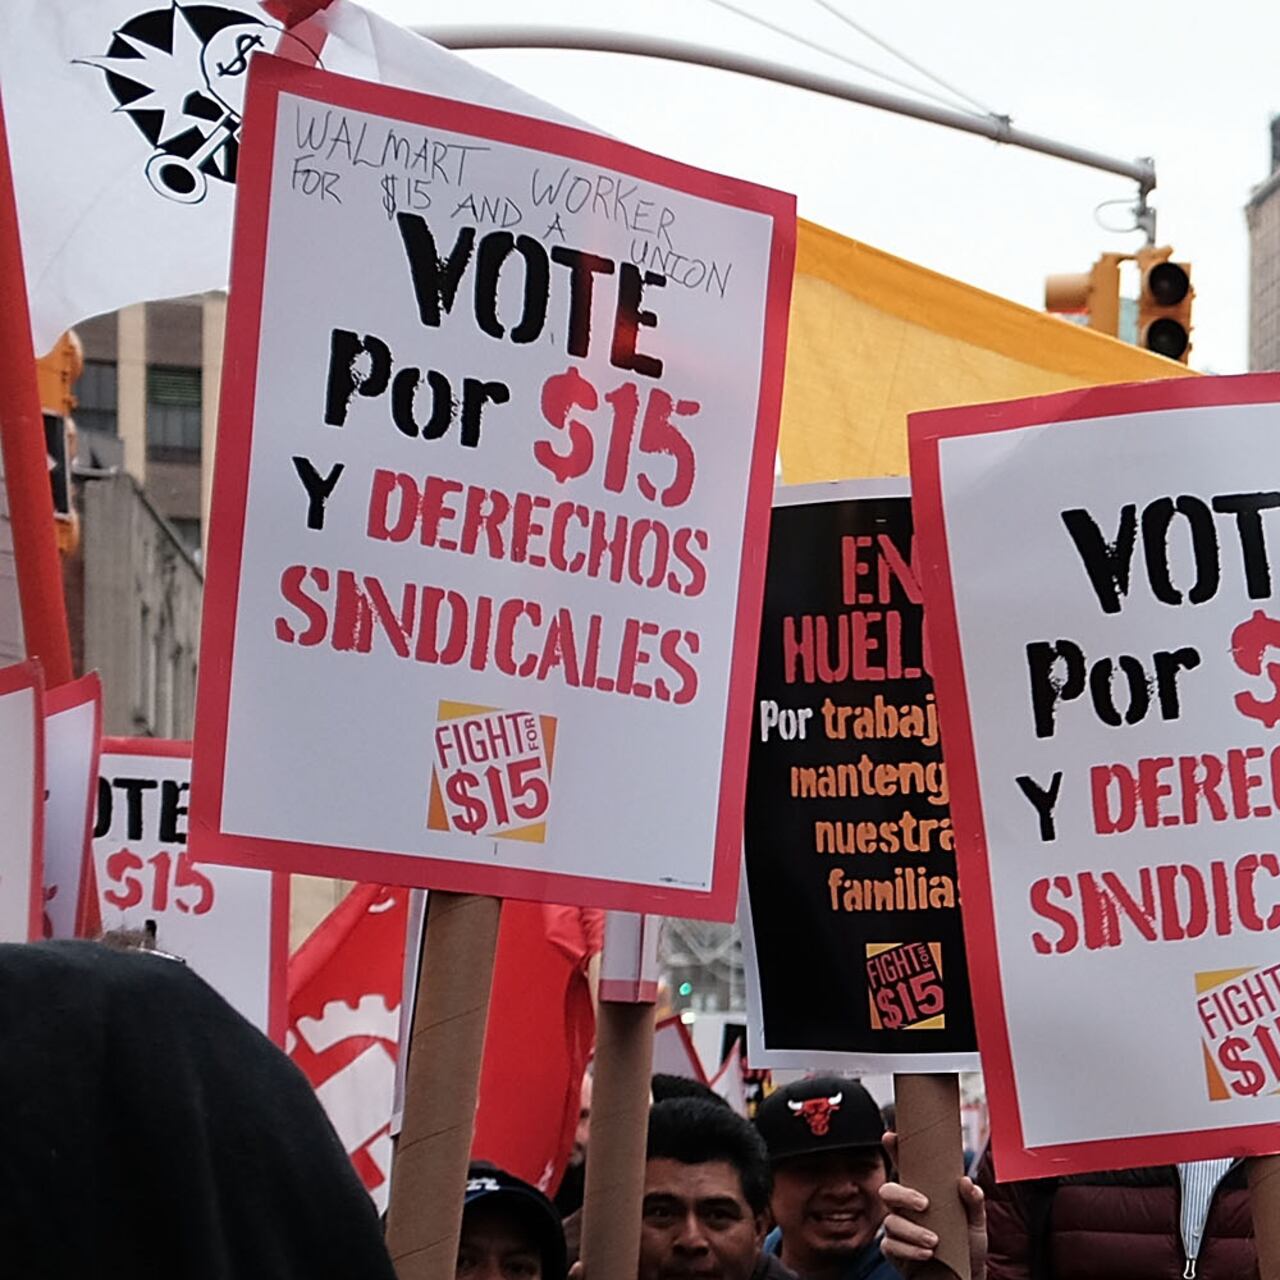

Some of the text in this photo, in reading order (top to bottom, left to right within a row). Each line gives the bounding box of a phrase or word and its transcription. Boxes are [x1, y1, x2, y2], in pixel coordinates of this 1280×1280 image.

[297, 105, 676, 249] WALMART WORKER
[291, 153, 733, 298] FOR $15 AND A UNION
[397, 211, 667, 380] VOTE
[323, 328, 701, 509] Por $15
[292, 456, 710, 599] Y DERECHOS
[841, 534, 925, 605] EN
[274, 564, 702, 706] SINDICALES
[783, 609, 935, 684] HUEL
[760, 693, 942, 746] Por trabaj
[1025, 639, 1200, 739] Por
[434, 711, 540, 770] FIGHT FOR
[445, 756, 550, 836] $15
[1015, 771, 1064, 843] Y
[103, 847, 215, 915] $15
[827, 866, 963, 913] familia
[866, 942, 932, 990] FIGHT FOR
[876, 970, 945, 1030] $15
